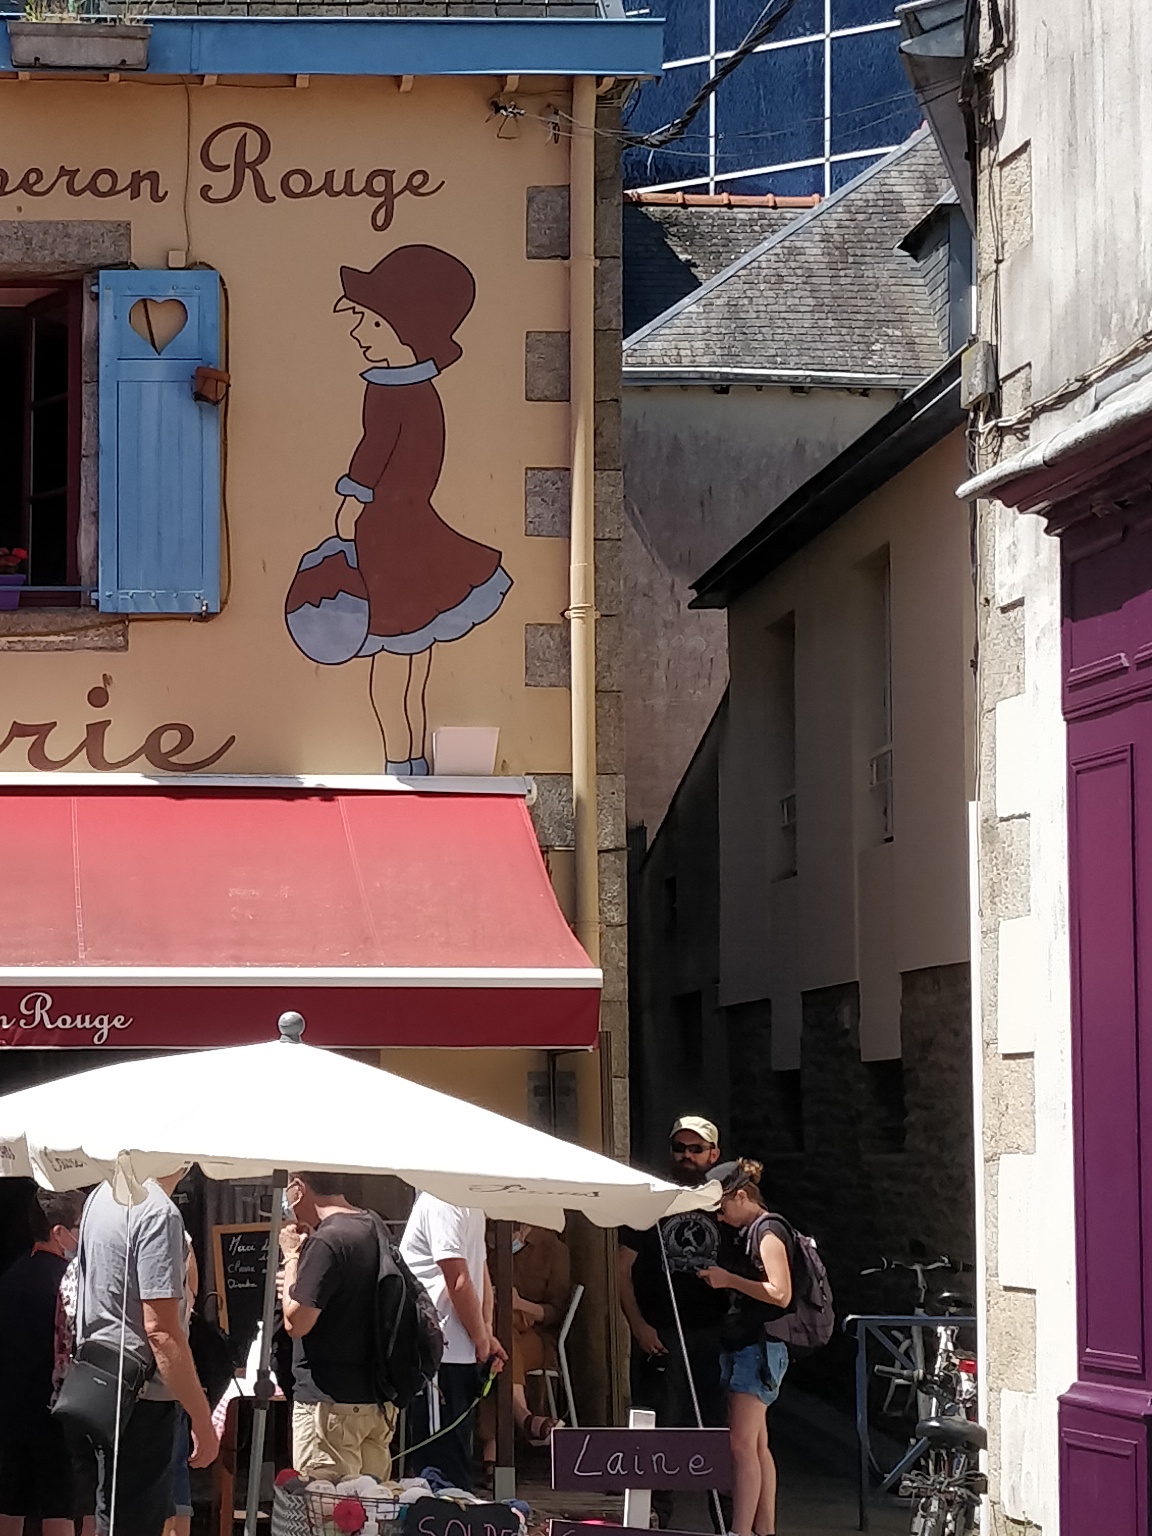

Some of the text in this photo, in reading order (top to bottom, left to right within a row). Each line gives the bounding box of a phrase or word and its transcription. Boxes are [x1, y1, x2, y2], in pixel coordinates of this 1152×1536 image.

[198, 120, 446, 232] Rouge
[19, 991, 134, 1045] Rouge
[573, 1434, 713, 1476] Laine
